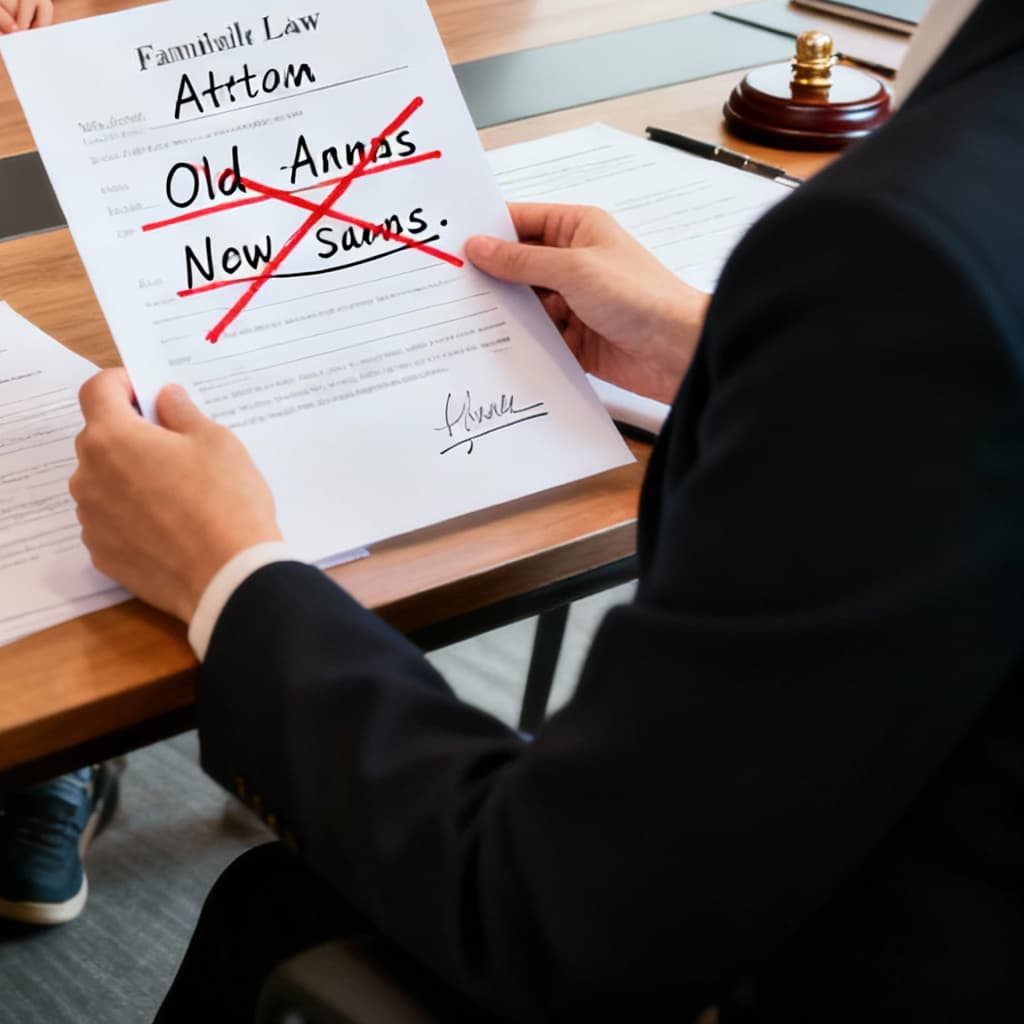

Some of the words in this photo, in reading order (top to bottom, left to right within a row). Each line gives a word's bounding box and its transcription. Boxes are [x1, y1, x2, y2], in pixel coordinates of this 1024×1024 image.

[262, 12, 321, 42] Law
[165, 144, 247, 209] Old
[184, 234, 273, 290] Now
